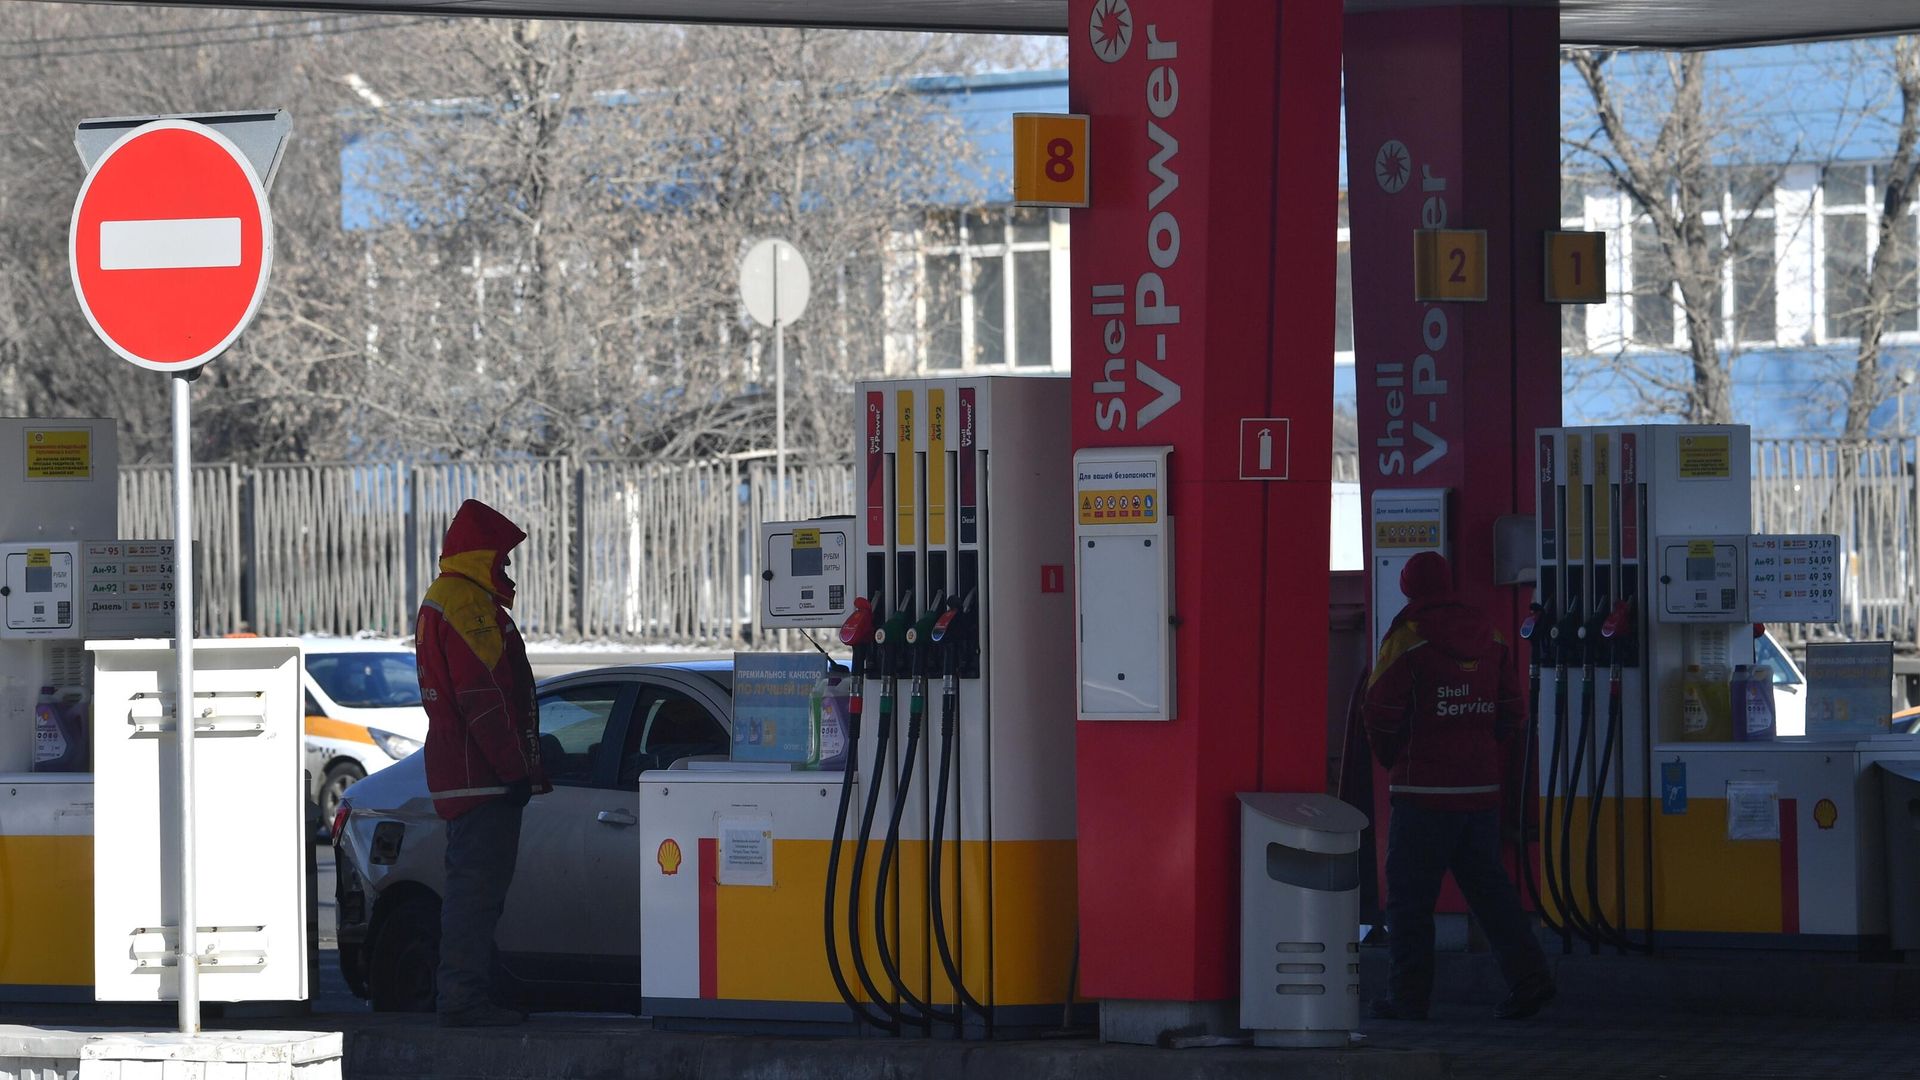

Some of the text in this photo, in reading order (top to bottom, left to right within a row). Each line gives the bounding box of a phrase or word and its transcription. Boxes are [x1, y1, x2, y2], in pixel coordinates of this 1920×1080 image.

[1045, 137, 1075, 183] 8
[1134, 23, 1182, 431] V-Power
[1448, 248, 1467, 283] 2
[1570, 251, 1581, 286] 1
[1412, 164, 1449, 475] V-Poer
[1090, 284, 1128, 432] Shell
[1376, 363, 1405, 477] Shell
[1079, 473, 1091, 481] Для
[1115, 471, 1156, 479] безопасности
[107, 547, 119, 555] 95
[91, 602, 122, 612] Дизель
[737, 670, 822, 679] ПРЕМИАЛЬНОЕ КАЧЕСТВО
[1436, 683, 1470, 698] Shell
[1436, 697, 1496, 717] Service
